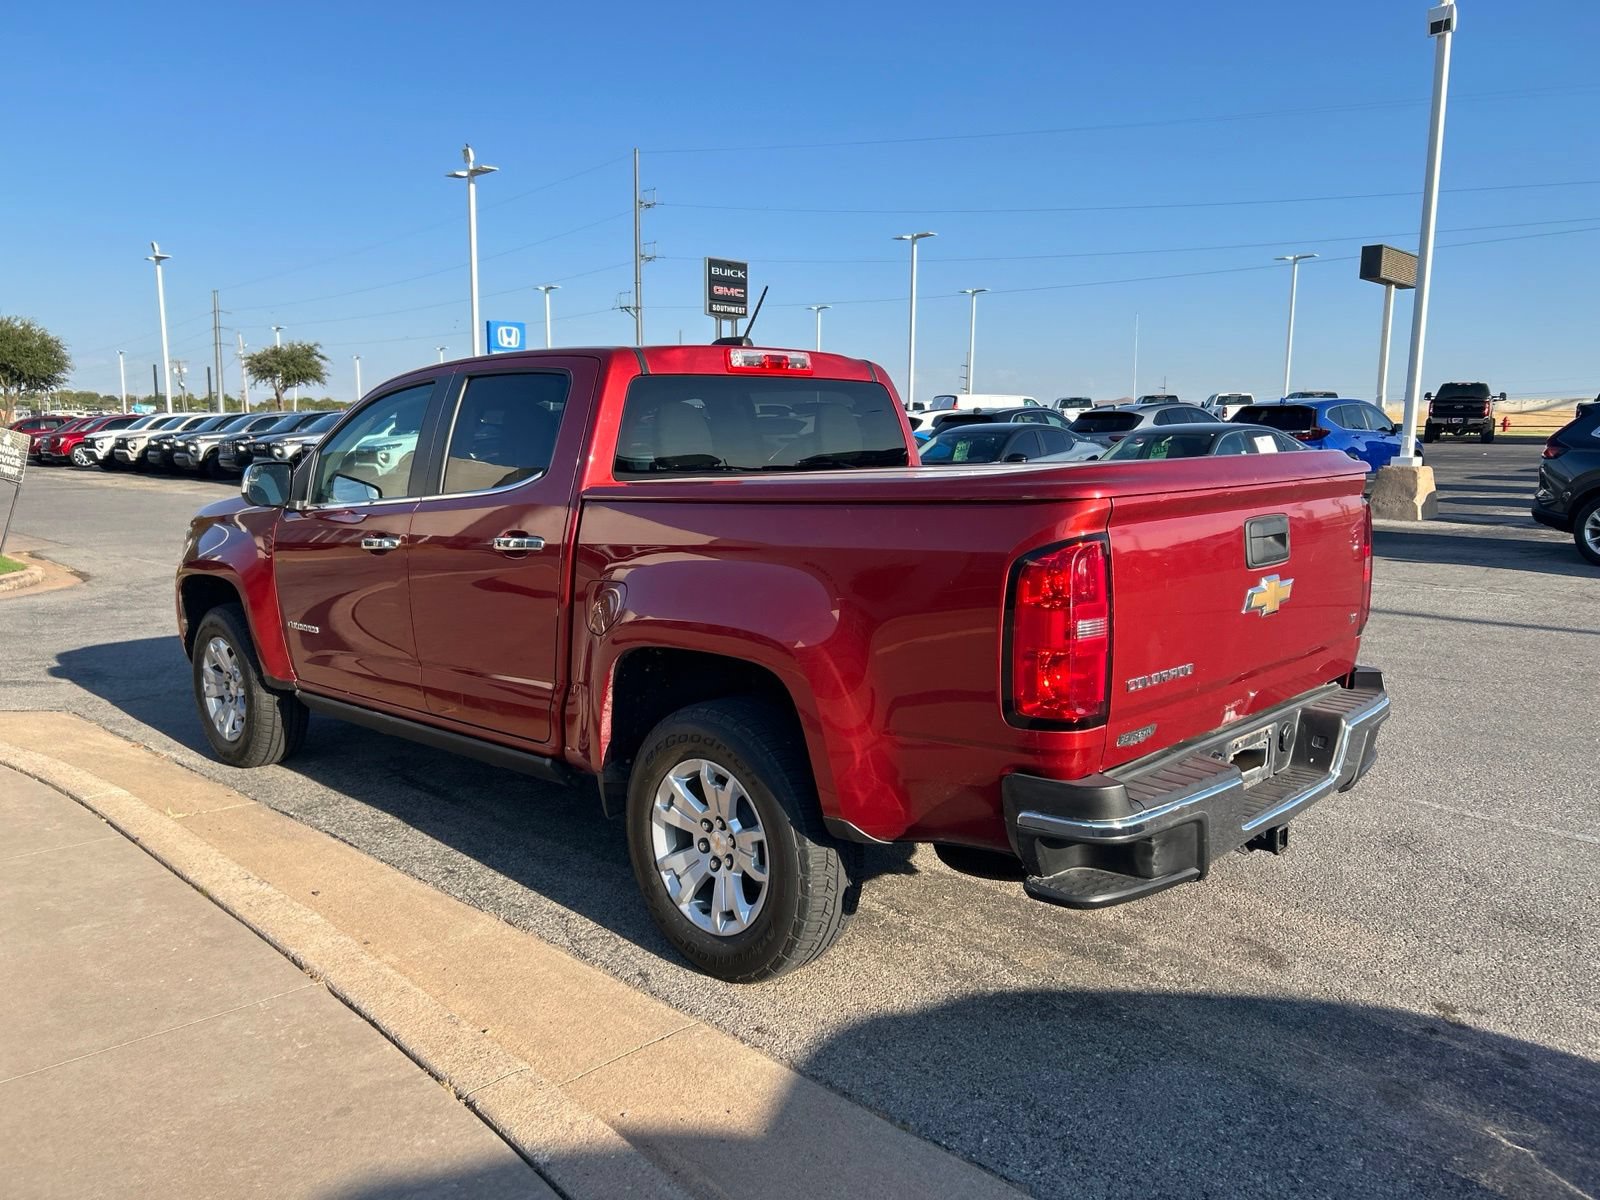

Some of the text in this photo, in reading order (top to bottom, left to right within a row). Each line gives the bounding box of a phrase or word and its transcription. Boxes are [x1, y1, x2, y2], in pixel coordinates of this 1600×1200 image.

[711, 267, 746, 279] BUICK
[713, 285, 745, 298] GMC
[712, 304, 746, 314] SOUTHWEST
